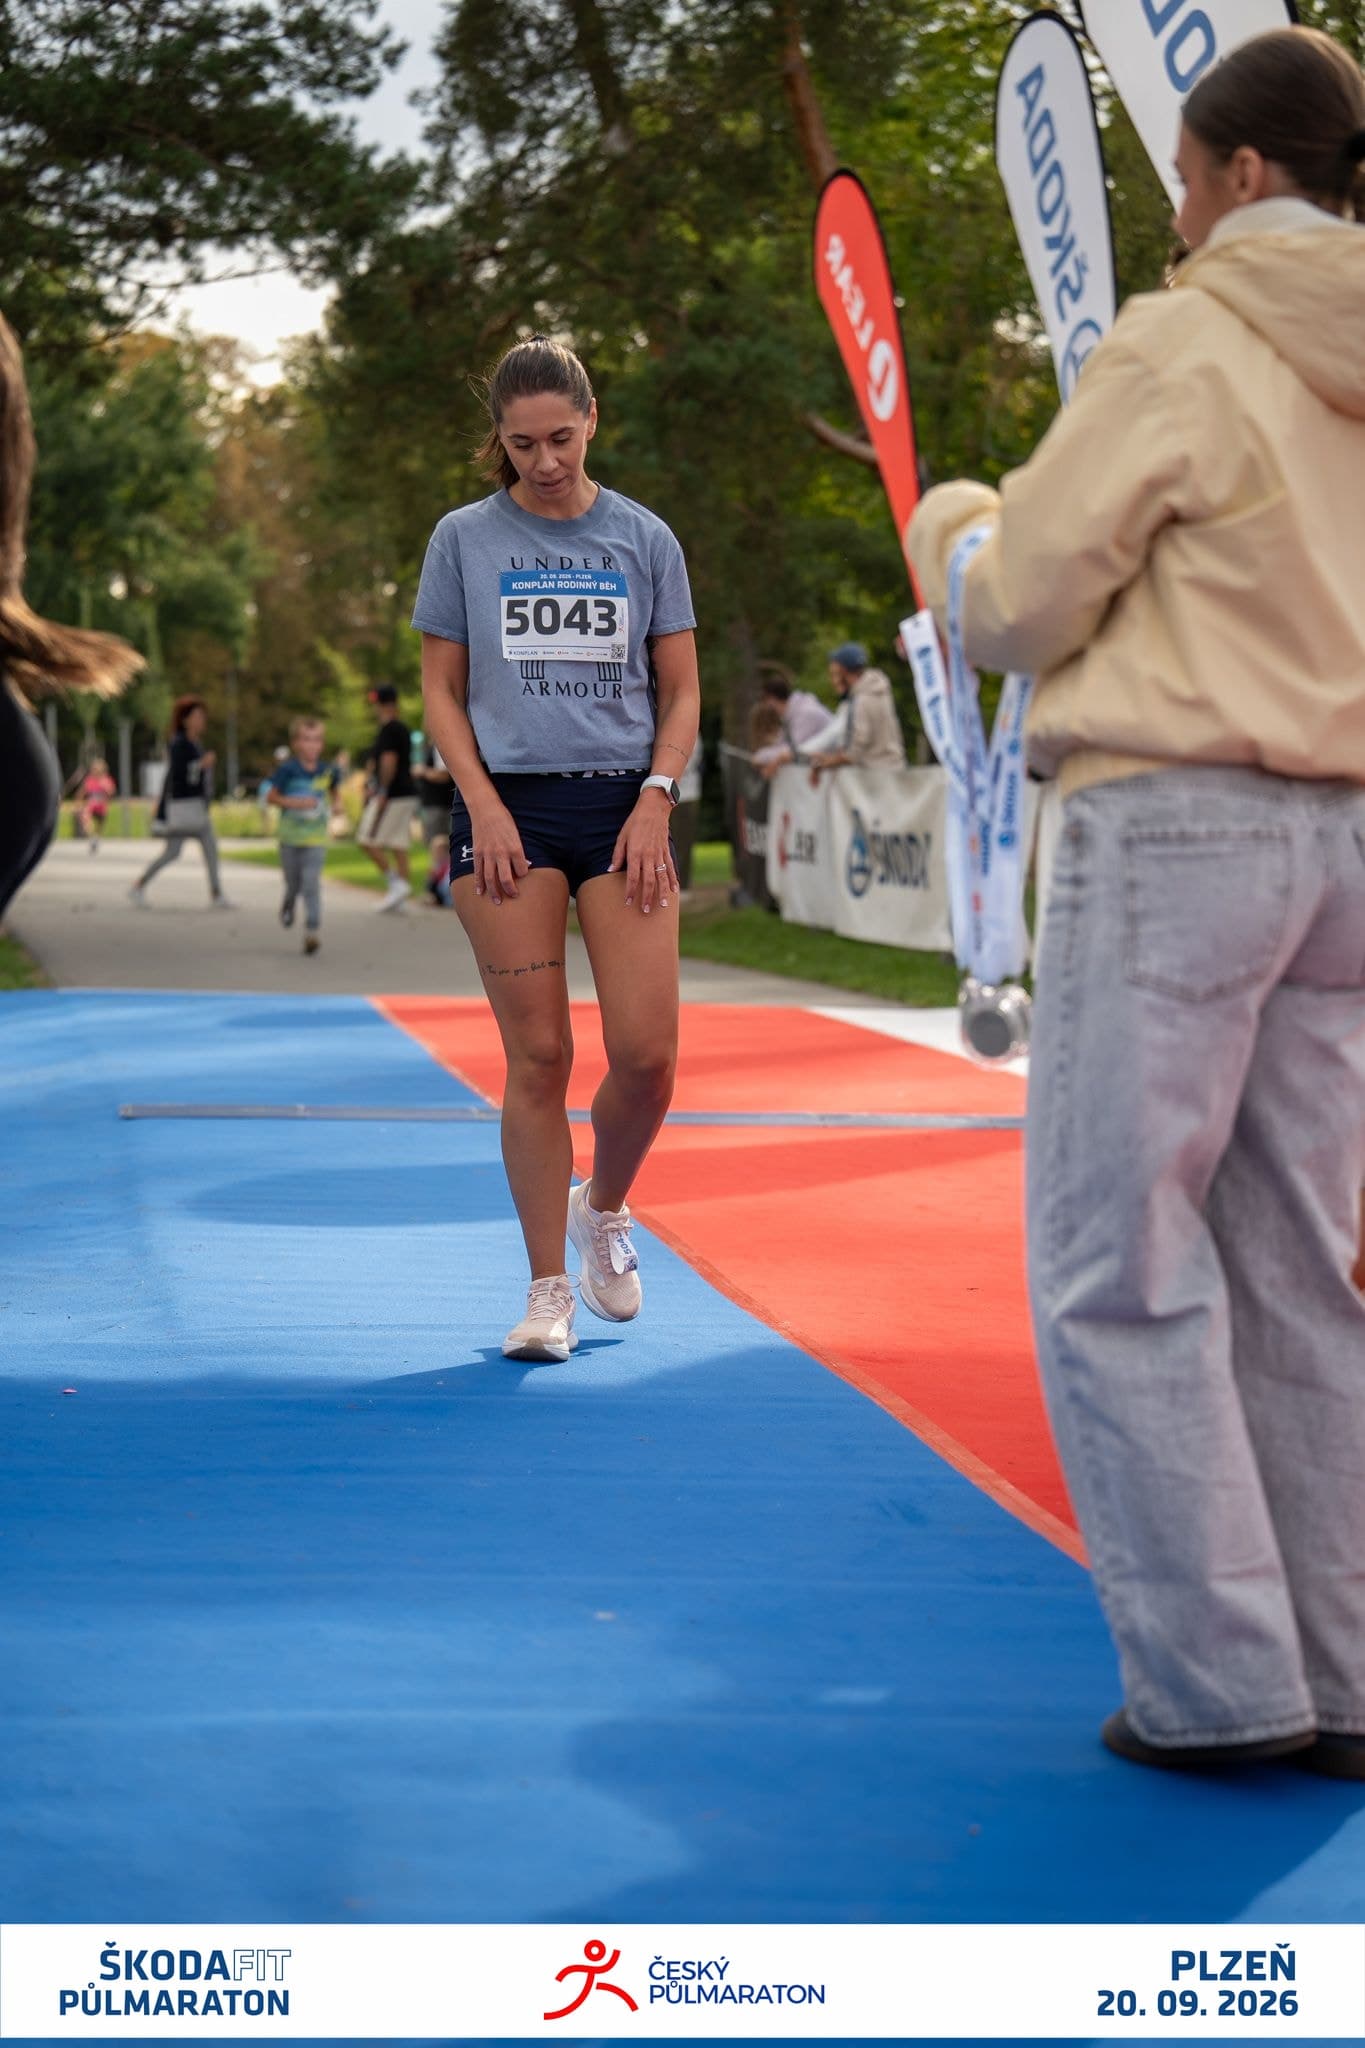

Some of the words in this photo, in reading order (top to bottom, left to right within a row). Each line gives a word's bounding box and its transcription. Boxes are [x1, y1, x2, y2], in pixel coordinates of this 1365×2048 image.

[511, 556, 613, 570] UNDER
[512, 581, 555, 590] KONPLAN
[557, 580, 598, 590] RODINNÝ
[600, 581, 617, 591] BĚH
[505, 598, 617, 637] 5043
[522, 681, 623, 699] ARMOUR
